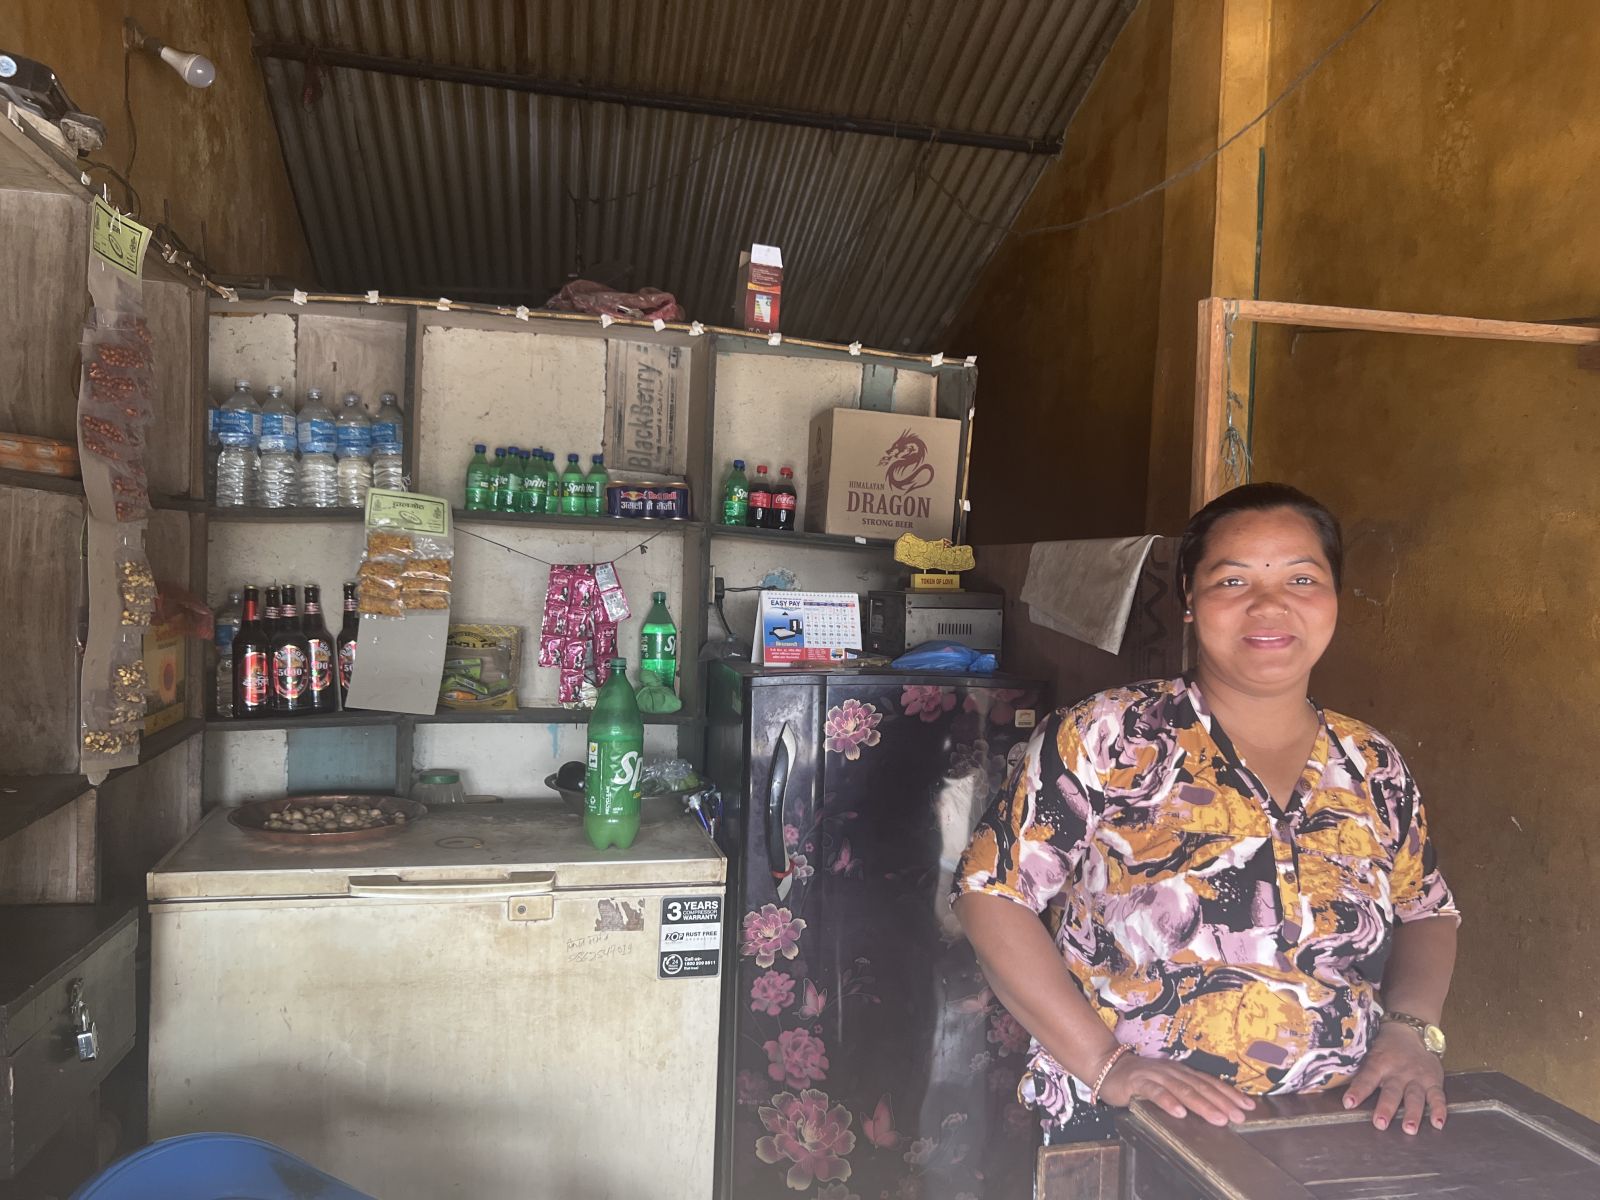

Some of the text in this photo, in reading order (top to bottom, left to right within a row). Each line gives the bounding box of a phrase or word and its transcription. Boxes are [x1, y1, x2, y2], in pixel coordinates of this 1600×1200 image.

[626, 362, 662, 469] BlackBerry
[848, 480, 885, 491] HIMALAYAN
[846, 490, 932, 518] DRAGON
[862, 518, 914, 529] STRONG BEER
[666, 900, 718, 922] 3 YEARS
